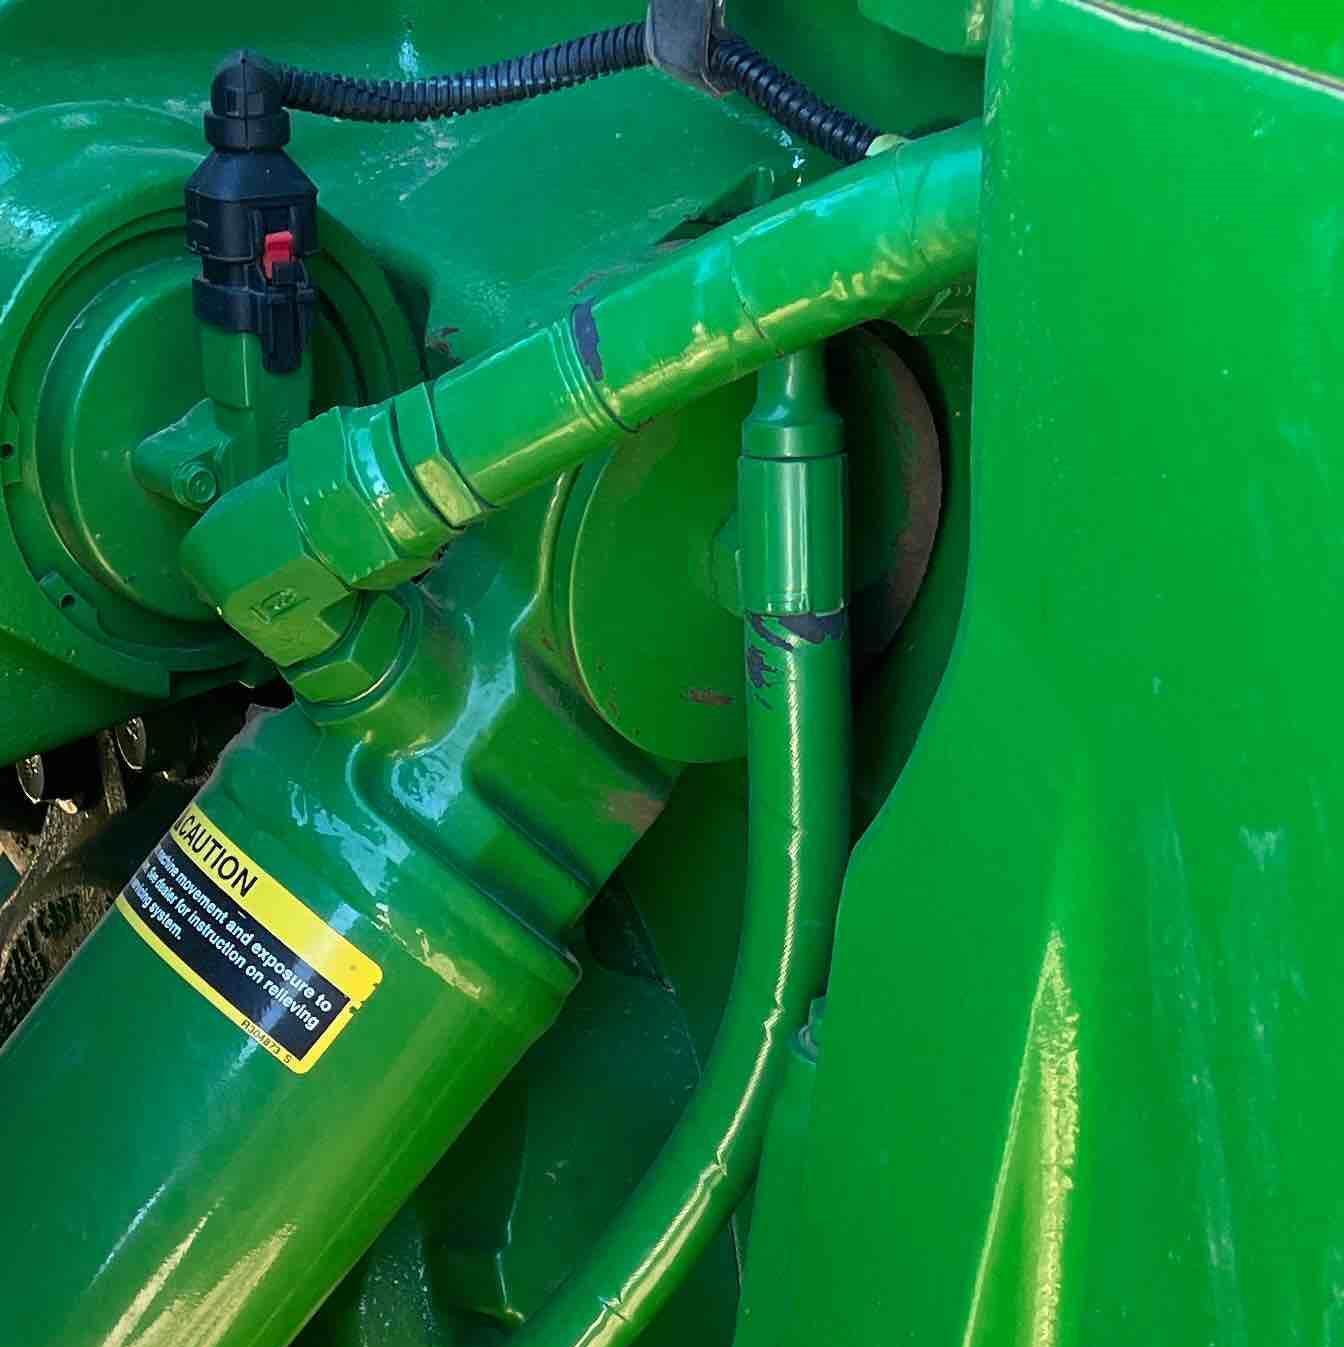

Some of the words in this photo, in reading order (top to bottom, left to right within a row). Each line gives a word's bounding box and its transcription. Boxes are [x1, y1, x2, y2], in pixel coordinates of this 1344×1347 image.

[179, 815, 258, 898] CAUTION
[148, 902, 182, 941] system.
[156, 878, 179, 905] dealer
[174, 898, 192, 917] for
[187, 910, 247, 969] instruction
[244, 965, 265, 984] on
[262, 979, 320, 1032] relieving
[176, 872, 229, 925] movement
[225, 920, 255, 946] and
[251, 942, 316, 999] exposure
[315, 993, 333, 1013] to
